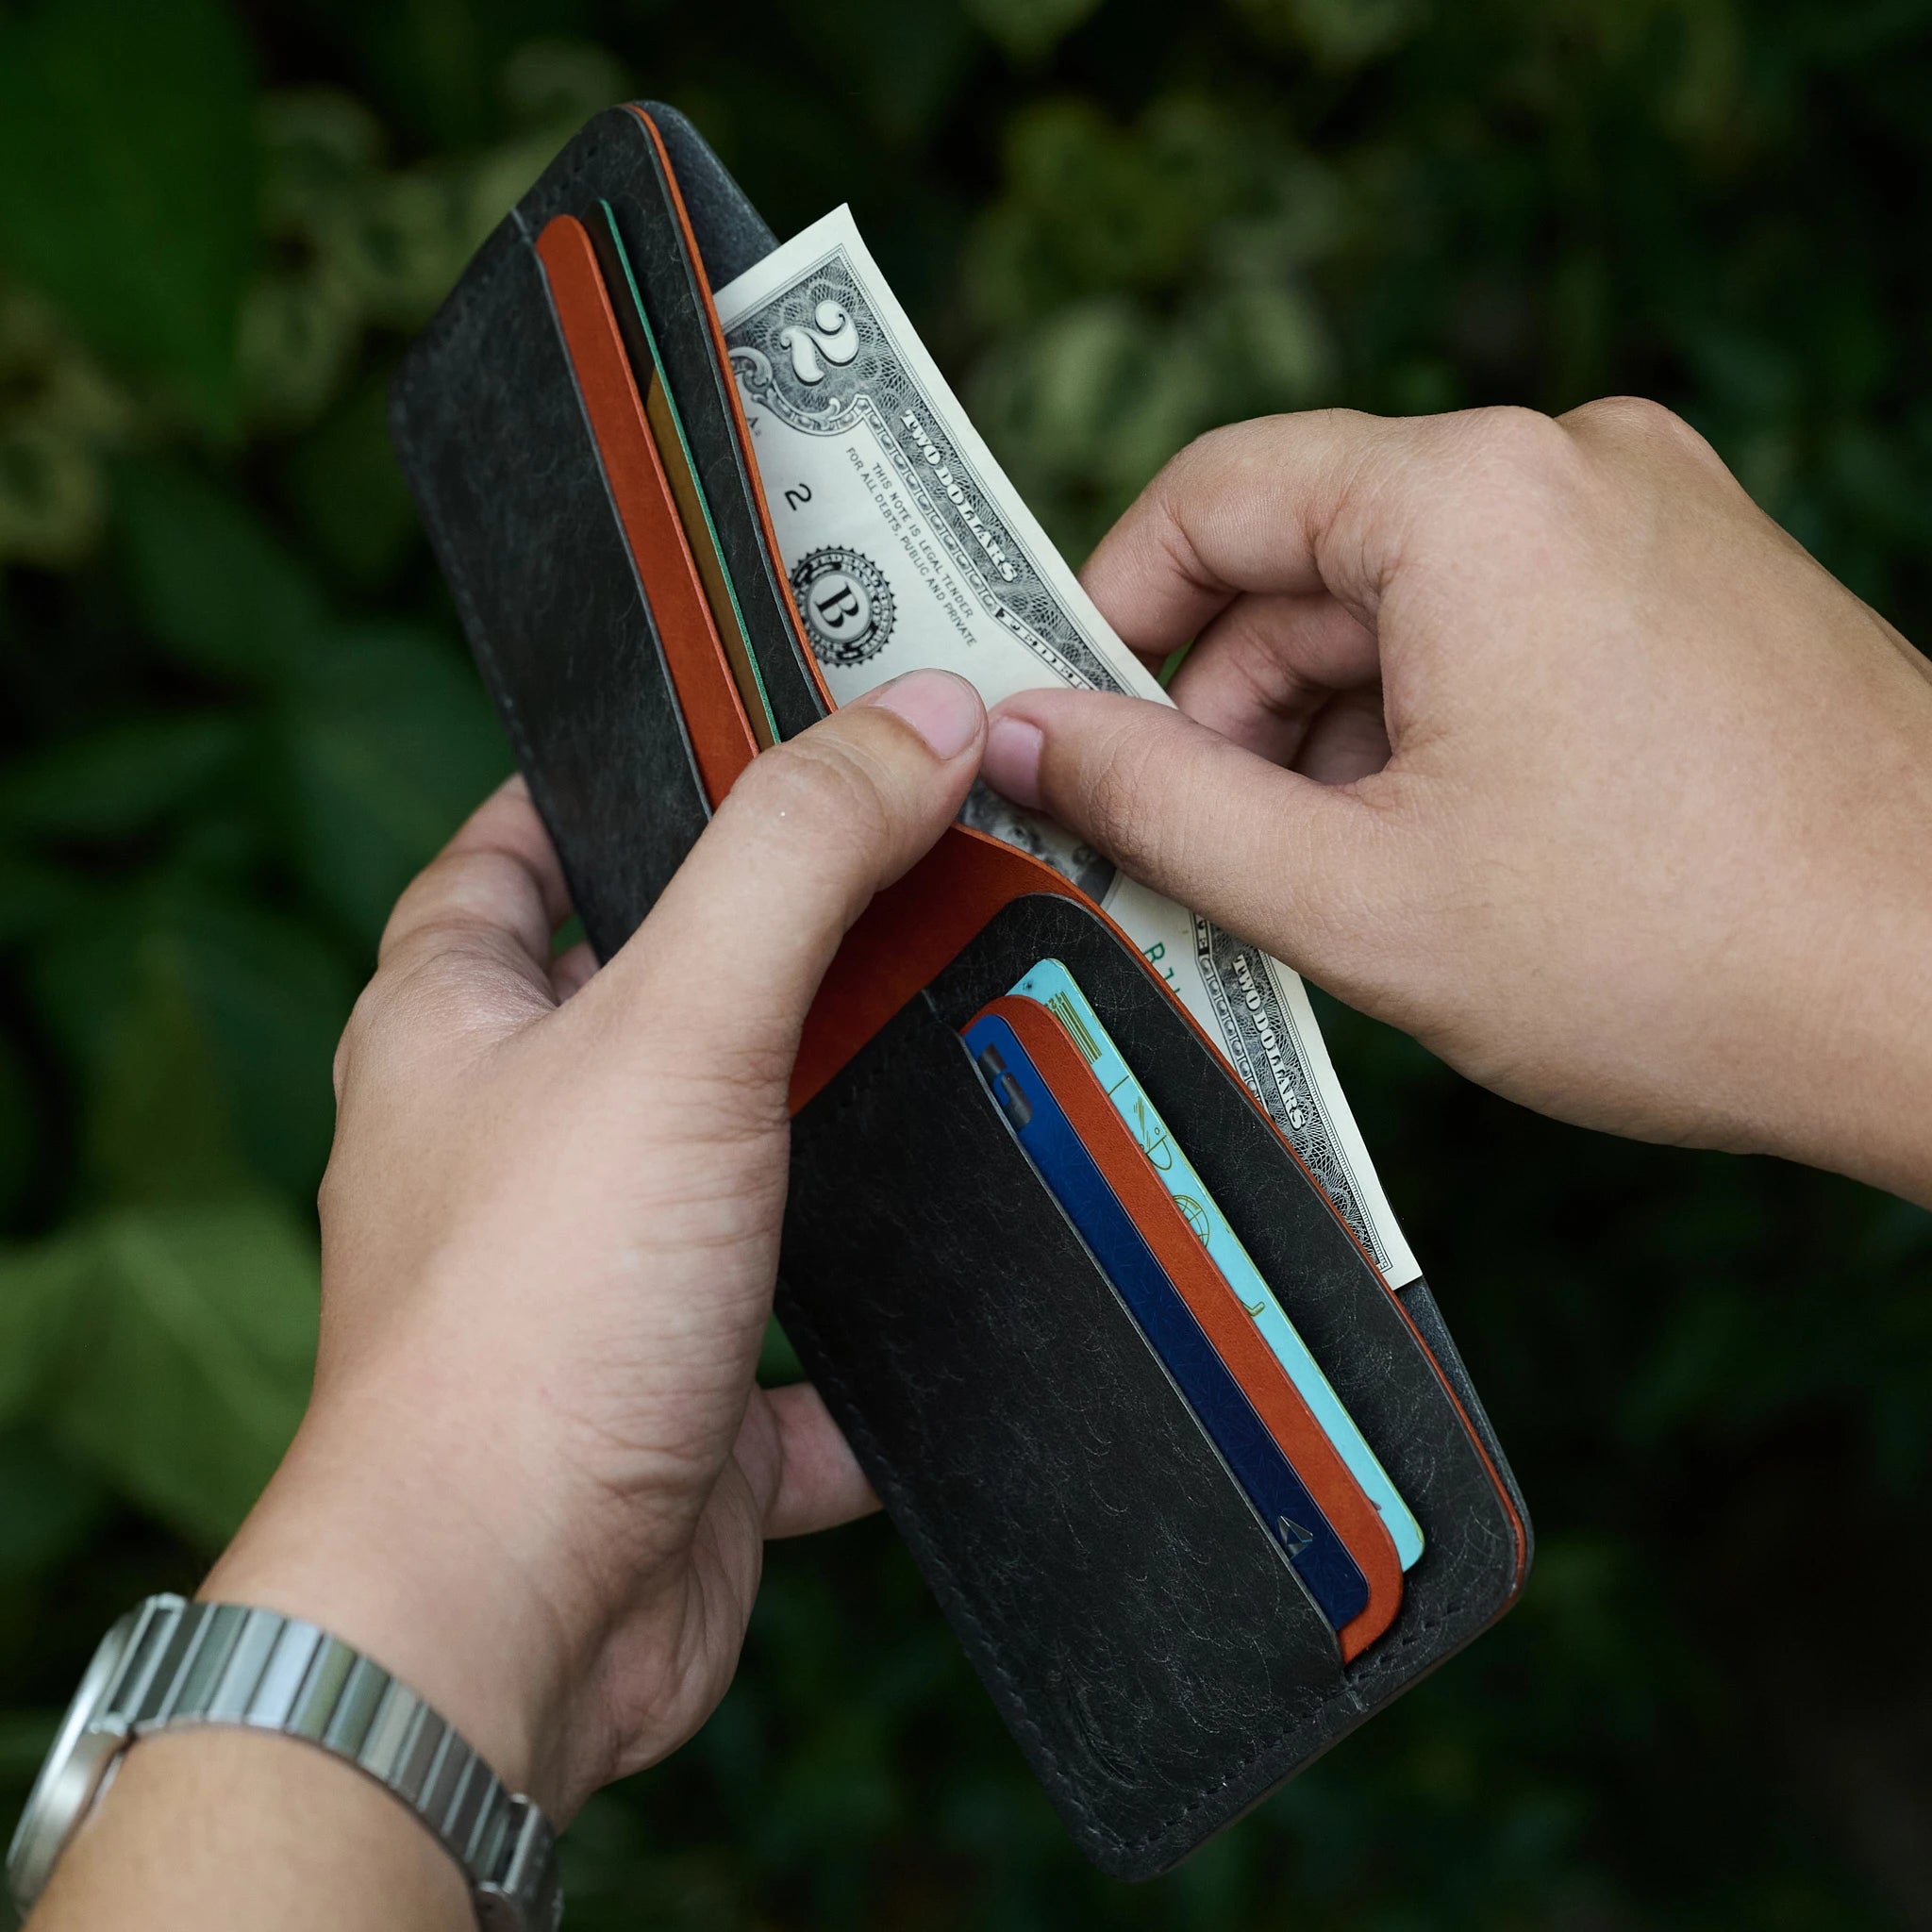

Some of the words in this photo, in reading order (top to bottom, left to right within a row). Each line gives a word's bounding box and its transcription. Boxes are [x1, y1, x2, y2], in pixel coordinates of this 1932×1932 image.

[779, 300, 859, 386] 2
[785, 482, 813, 510] 2
[846, 447, 864, 470] FOR
[860, 472, 877, 493] ALL
[874, 494, 902, 536] DEBTS,
[901, 537, 929, 575] PUBLIC
[926, 576, 946, 602] AND
[943, 602, 975, 646] PRIVATE
[874, 463, 892, 490] THIS
[890, 491, 911, 523] NOTE
[908, 524, 922, 538] IS
[920, 539, 943, 575] LEGAL
[941, 573, 973, 619] TENDER
[900, 409, 941, 466] TWO
[934, 466, 1017, 583] DOLLARS
[813, 581, 858, 627] B
[1231, 955, 1260, 1011] TWO
[1252, 1012, 1306, 1130] DOLLARS
